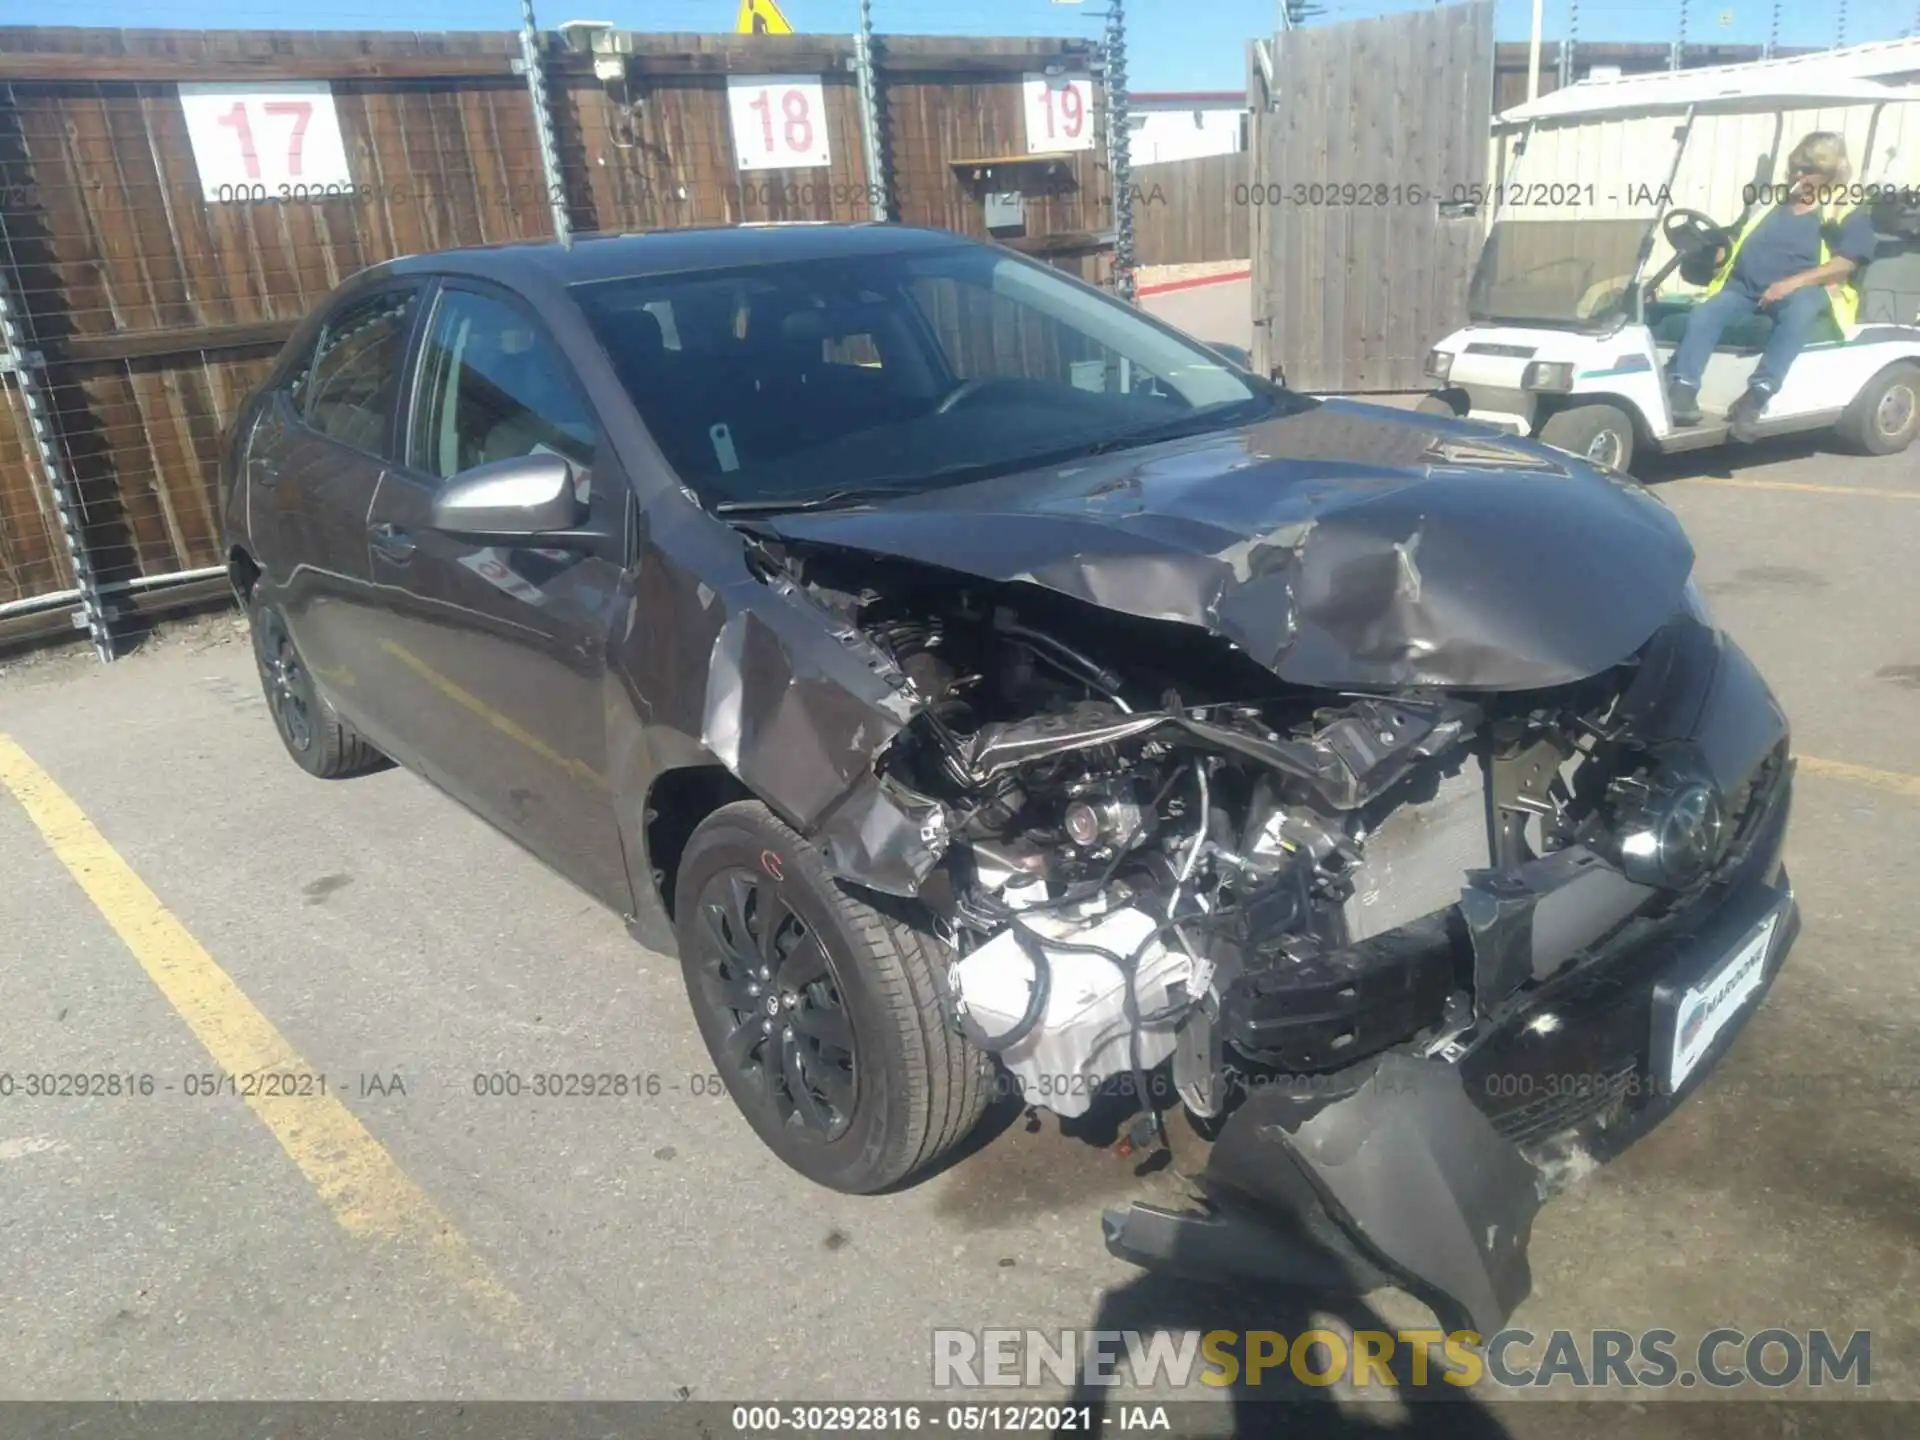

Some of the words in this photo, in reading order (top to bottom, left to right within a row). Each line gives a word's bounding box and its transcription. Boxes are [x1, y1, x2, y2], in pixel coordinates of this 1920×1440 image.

[217, 101, 314, 179] 17
[749, 89, 813, 153] 18
[1038, 83, 1083, 138] 19
